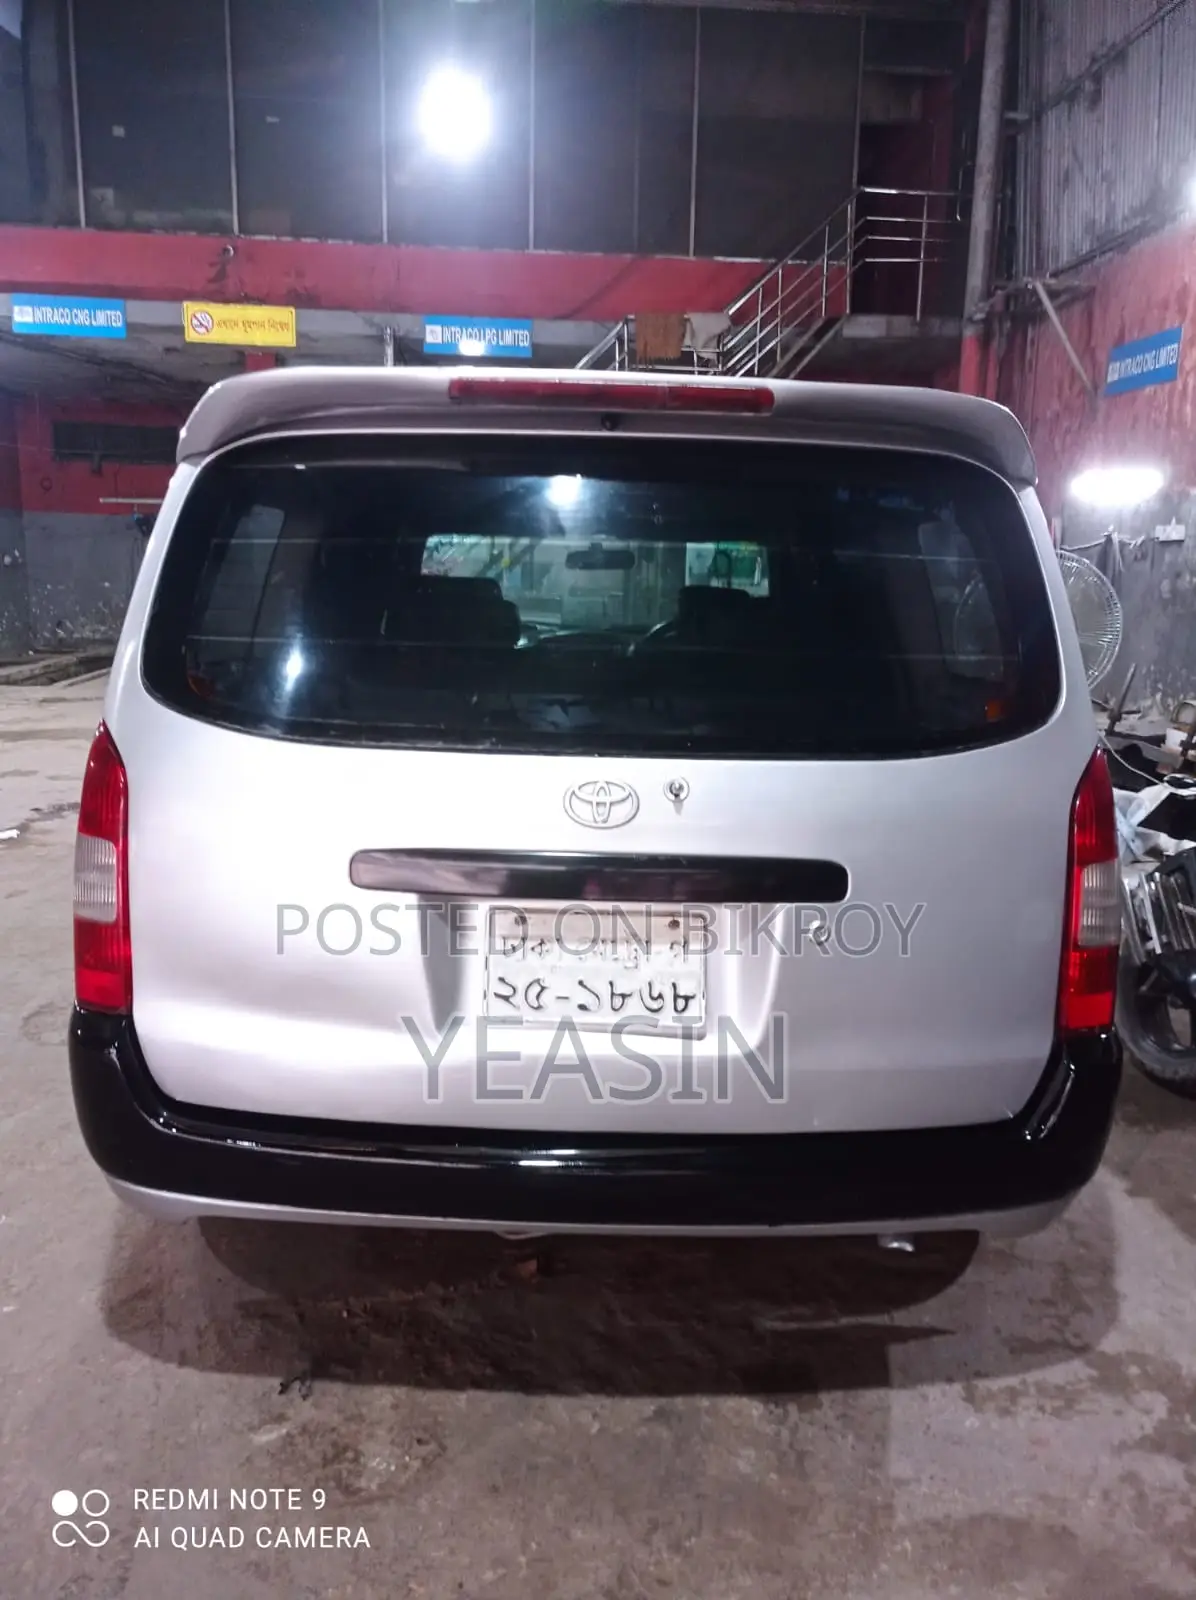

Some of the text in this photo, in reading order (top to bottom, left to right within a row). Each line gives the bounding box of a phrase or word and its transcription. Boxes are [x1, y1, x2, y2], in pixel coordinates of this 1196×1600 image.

[33, 305, 123, 328] INTRACO CNG LIMITED
[442, 325, 530, 347] INTRACO LPG LIMITED
[1155, 343, 1179, 369] LIMITED
